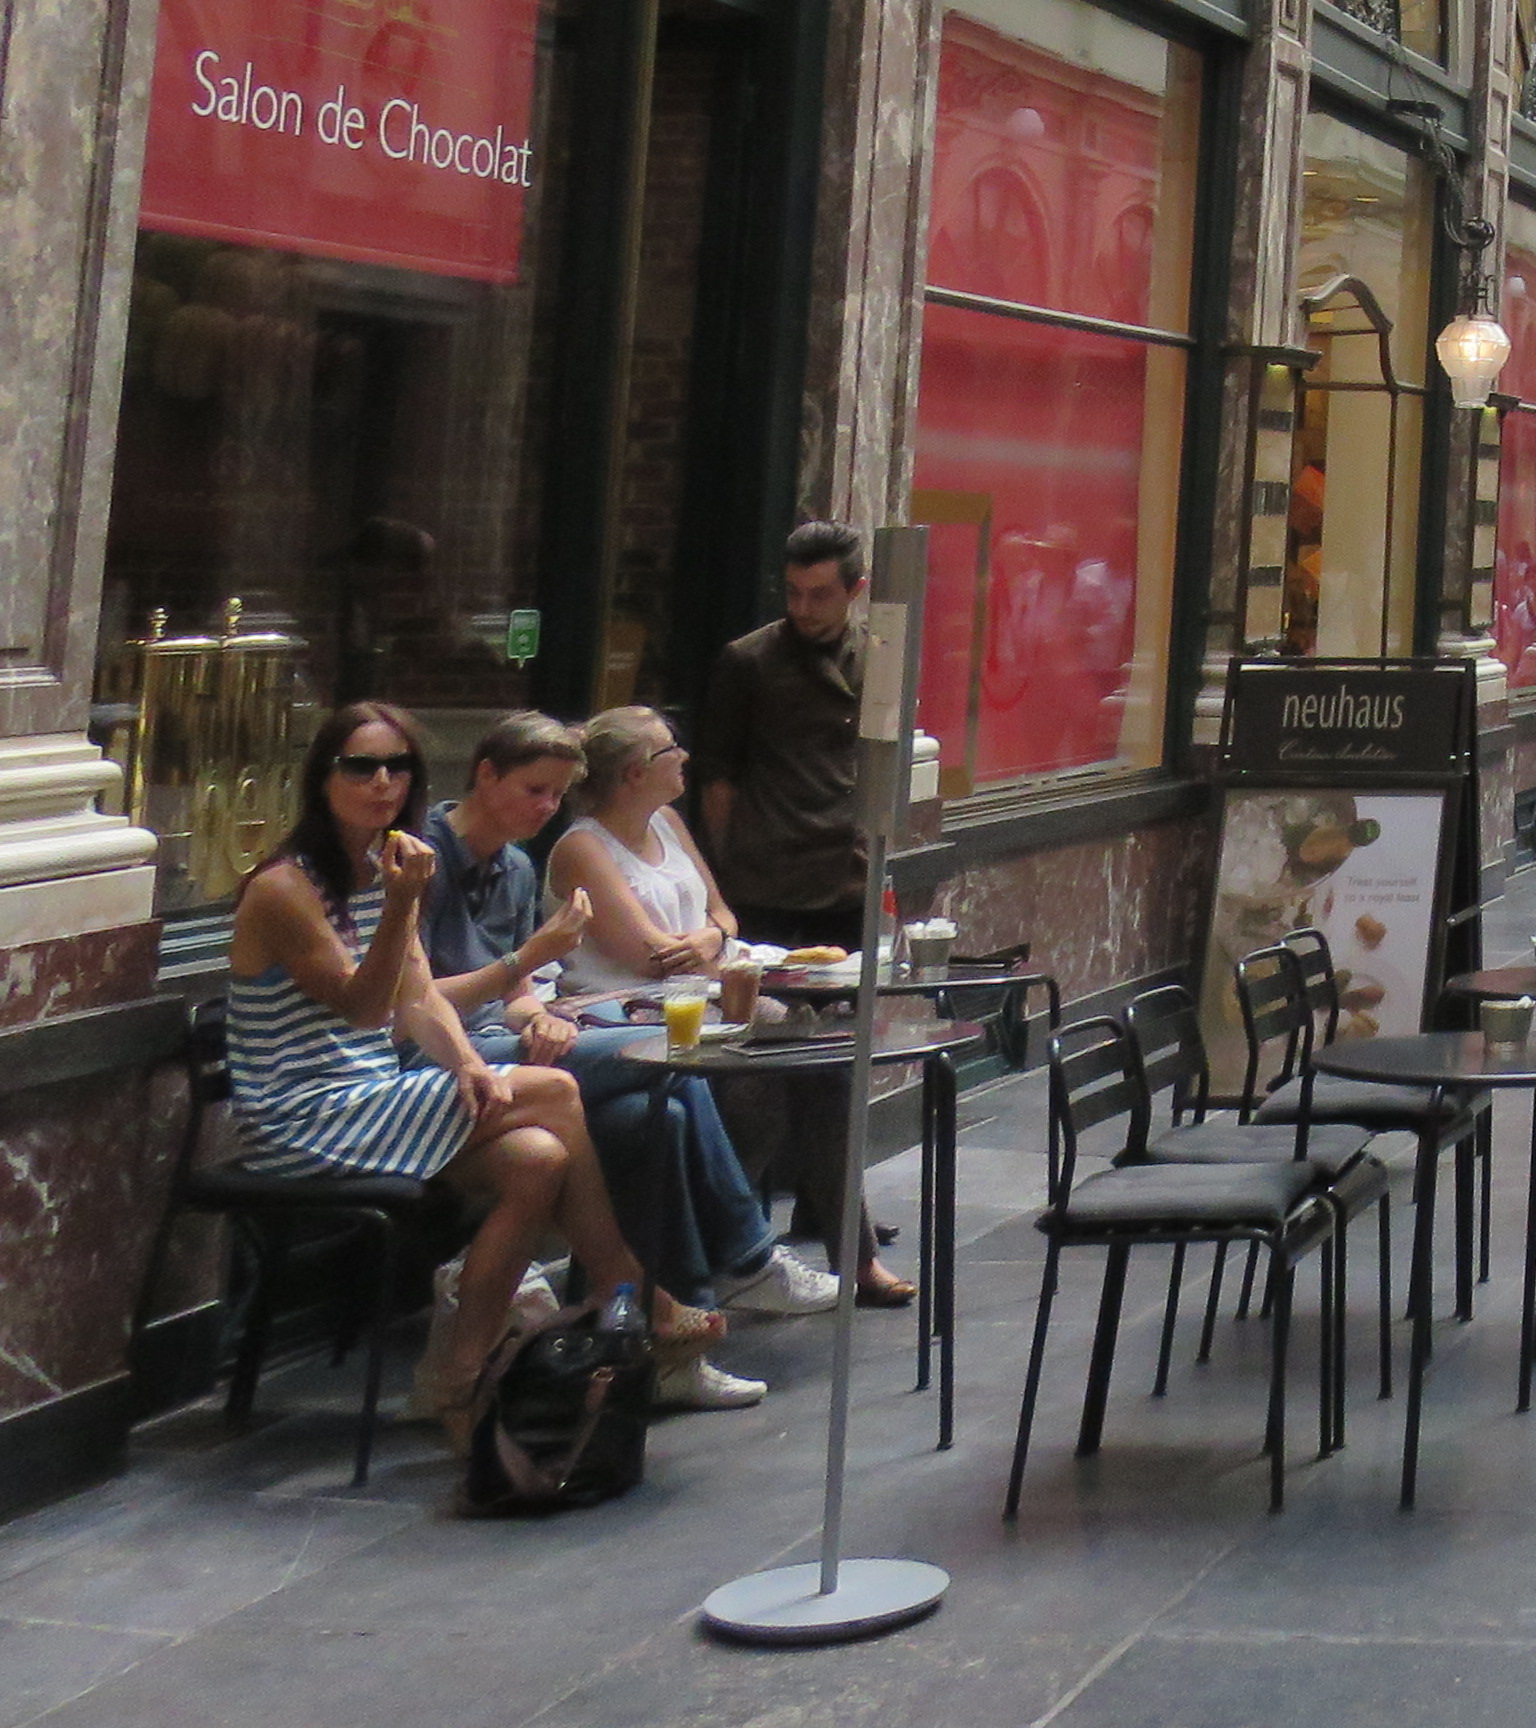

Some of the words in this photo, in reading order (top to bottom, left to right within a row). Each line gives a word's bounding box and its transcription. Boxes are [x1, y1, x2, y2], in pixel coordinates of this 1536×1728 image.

[192, 50, 303, 136] Salon
[317, 84, 366, 150] de
[379, 98, 533, 188] Chocolat
[1281, 683, 1405, 729] neuhaus
